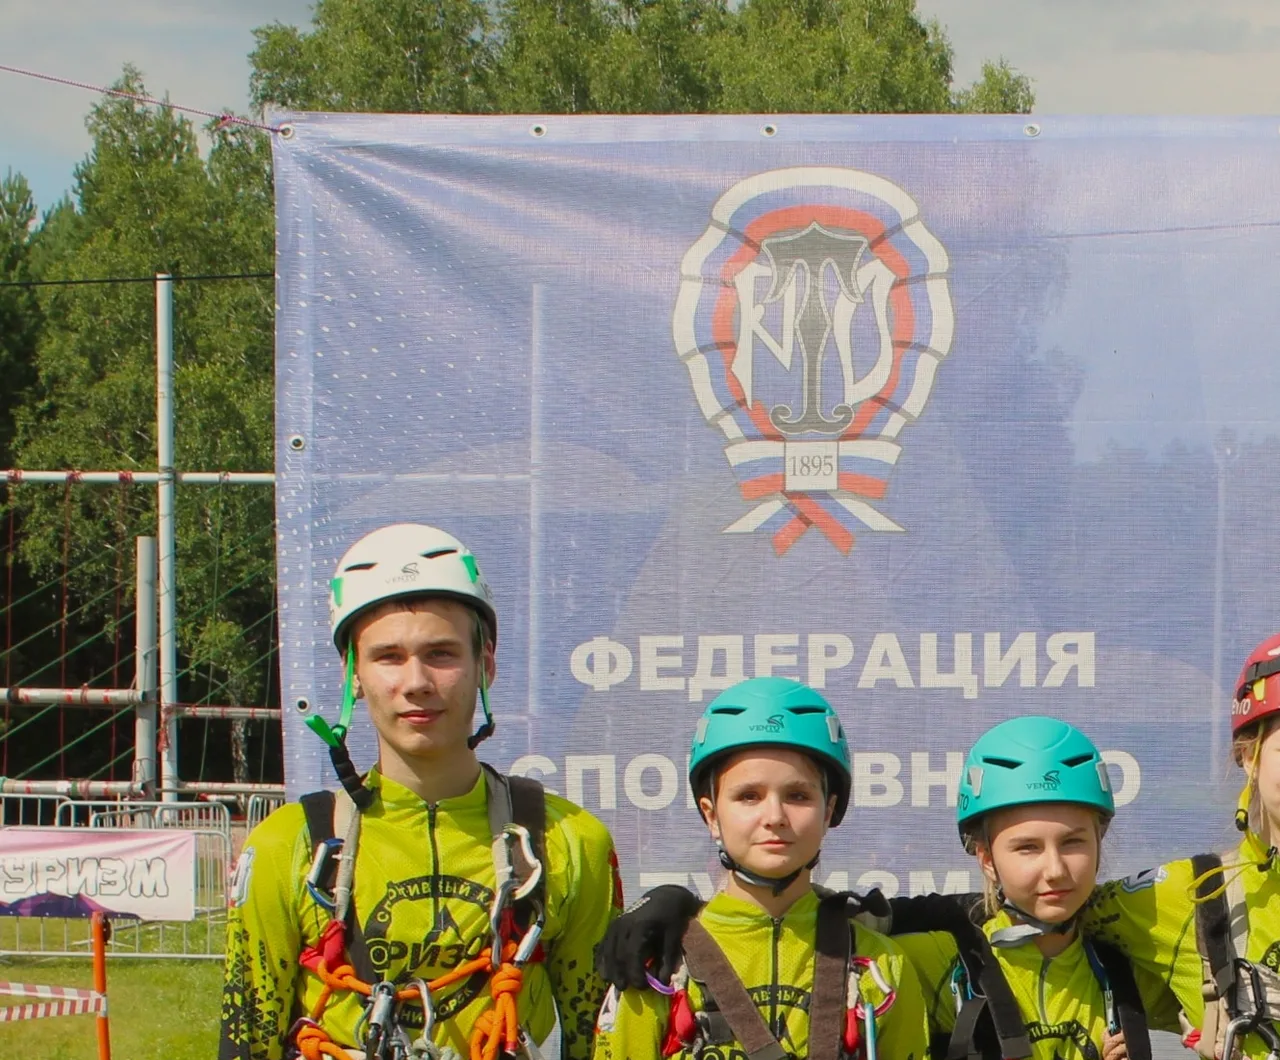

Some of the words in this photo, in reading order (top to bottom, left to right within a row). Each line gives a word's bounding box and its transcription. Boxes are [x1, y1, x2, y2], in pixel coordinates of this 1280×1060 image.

[790, 455, 834, 477] 1895
[569, 631, 1096, 700] ФЕДЕРАЦИЯ
[1026, 782, 1058, 791] VENTO
